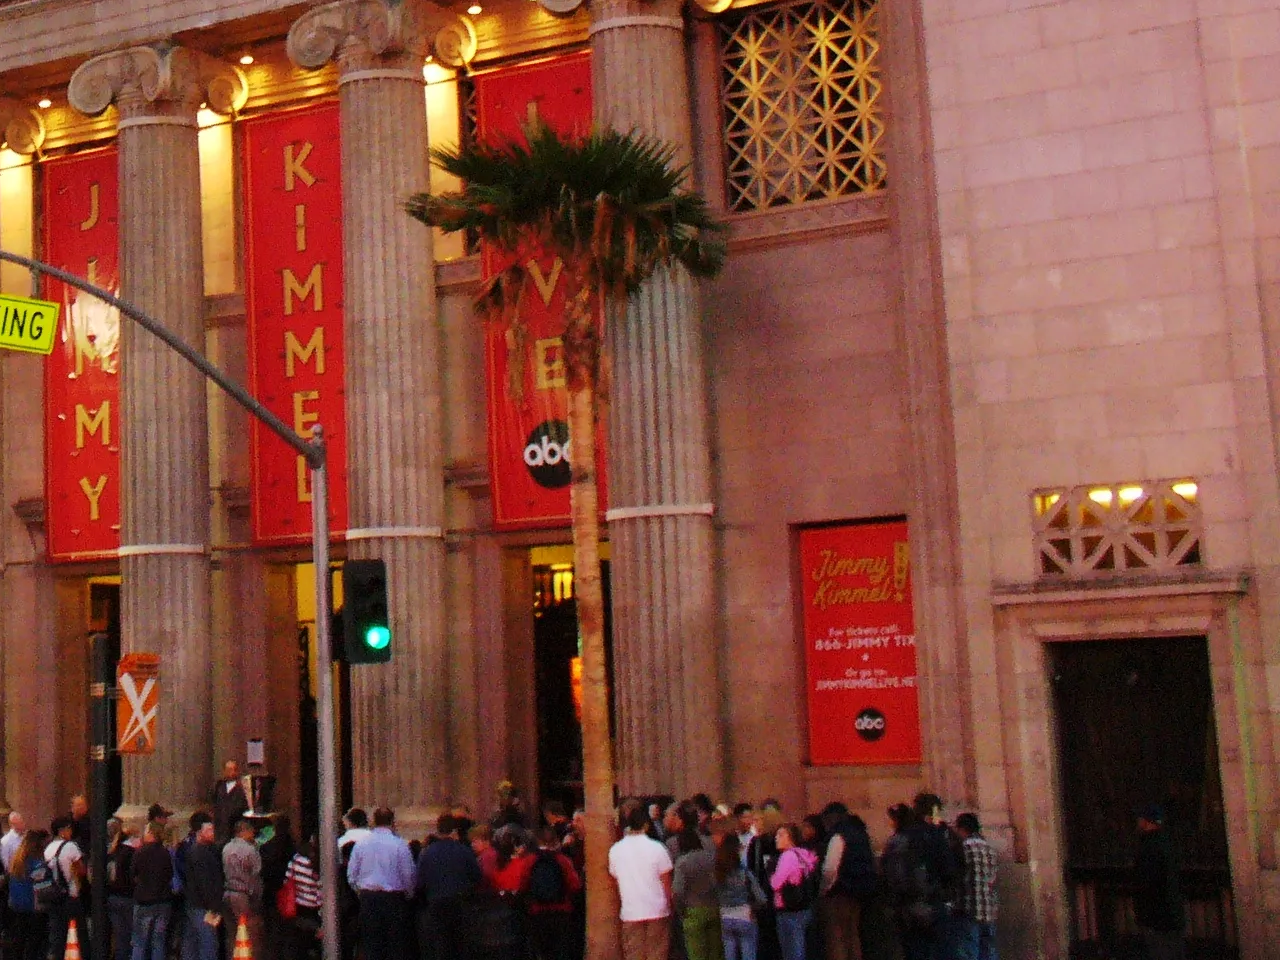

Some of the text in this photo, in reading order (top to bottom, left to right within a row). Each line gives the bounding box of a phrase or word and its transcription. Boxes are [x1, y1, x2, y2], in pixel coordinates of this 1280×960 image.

[281, 141, 325, 503] KIMMEL
[812, 549, 889, 584] Jimmy
[854, 715, 885, 730] abc
